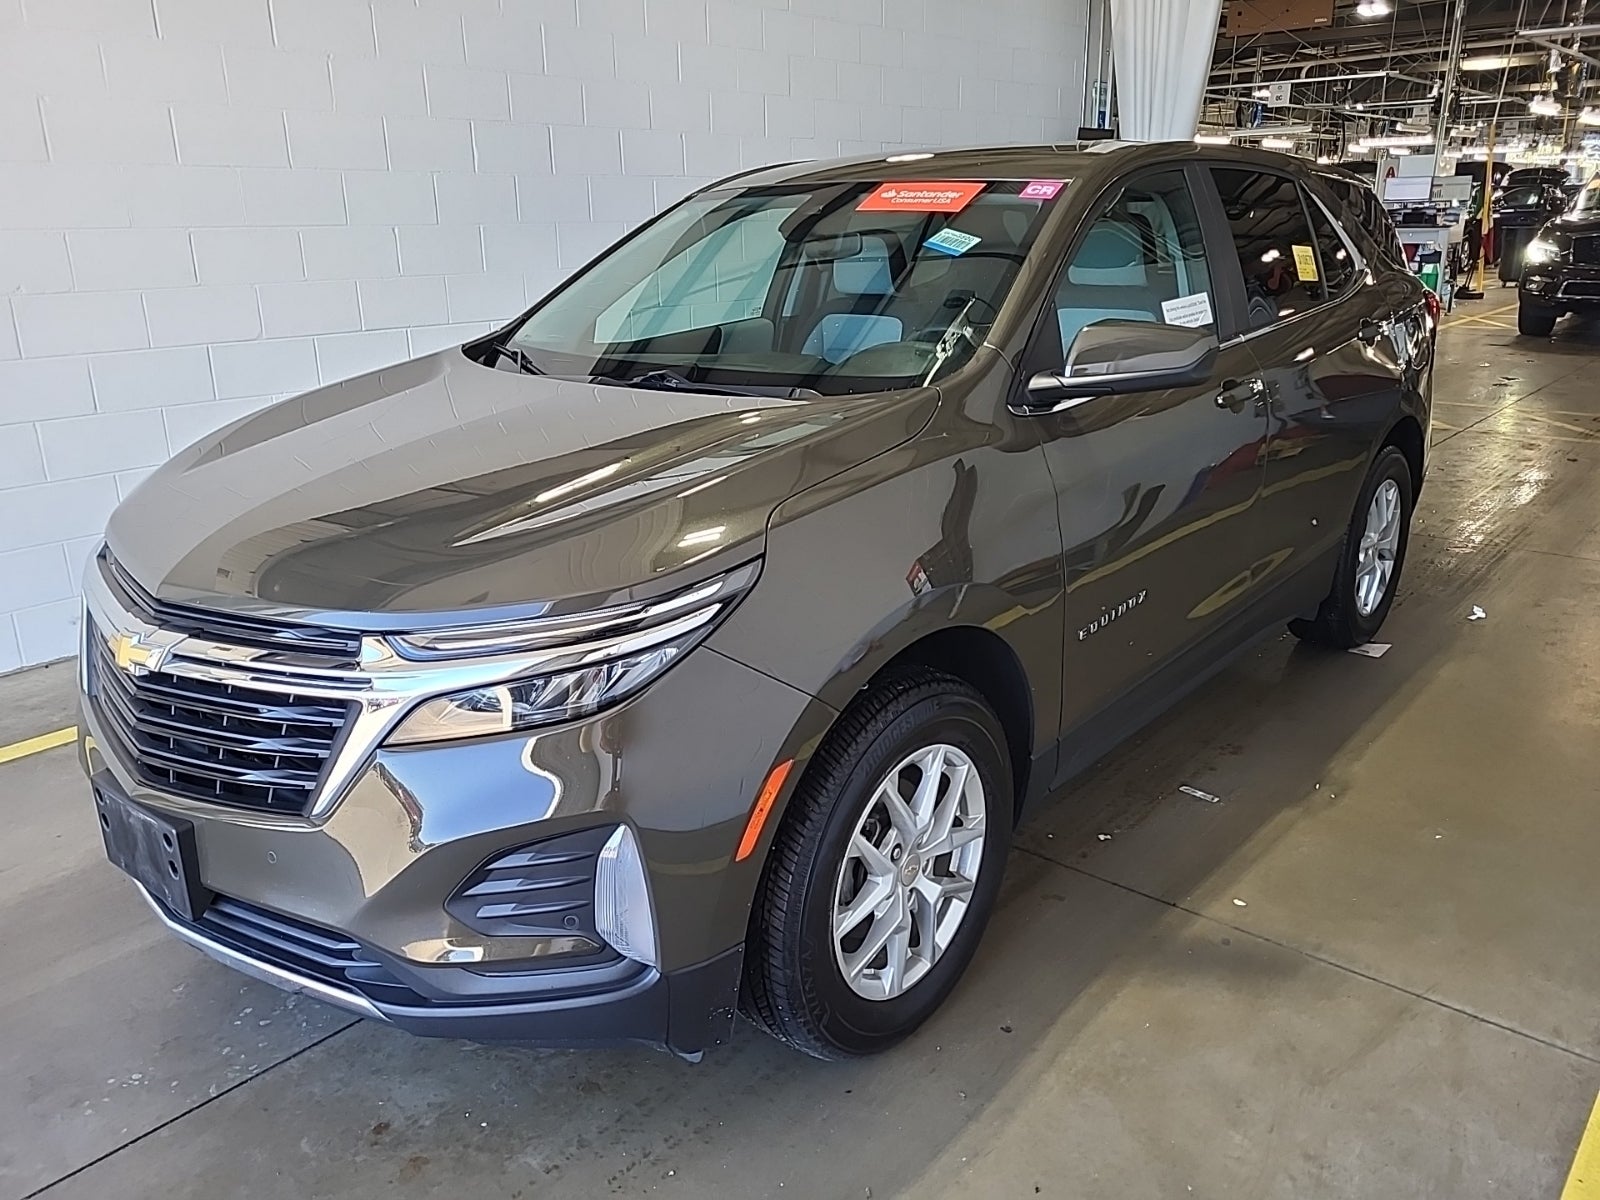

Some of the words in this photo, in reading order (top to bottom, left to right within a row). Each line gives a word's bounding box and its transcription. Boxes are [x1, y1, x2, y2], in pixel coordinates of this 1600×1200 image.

[896, 189, 963, 199] Santander
[1026, 184, 1055, 196] CR
[890, 197, 933, 205] Consumer
[933, 197, 951, 205] USA
[1078, 589, 1148, 641] EQUINOX
